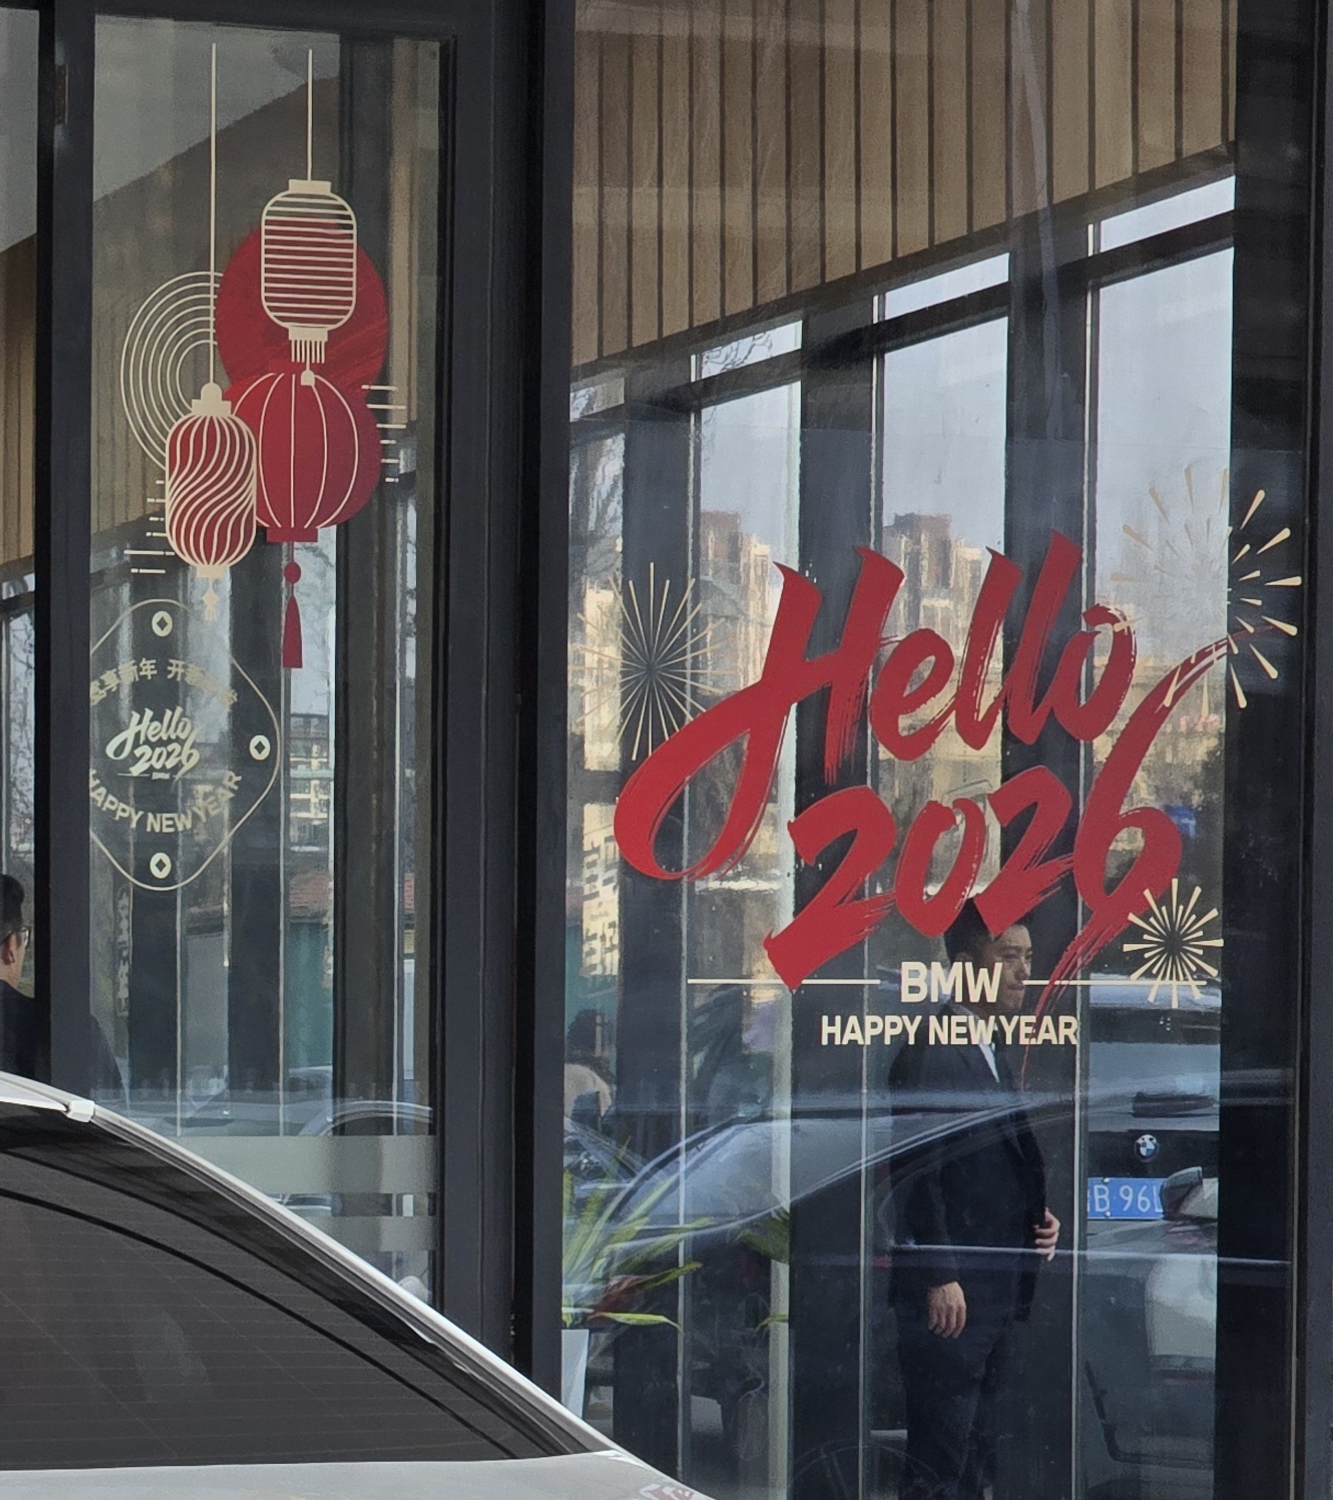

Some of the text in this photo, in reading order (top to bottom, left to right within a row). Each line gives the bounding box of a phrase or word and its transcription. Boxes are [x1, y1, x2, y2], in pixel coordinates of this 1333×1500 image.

[105, 705, 190, 760] Hello
[613, 531, 1138, 881] Hello
[129, 725, 203, 786] 2026
[146, 812, 192, 833] NEW
[192, 770, 242, 823] YEAR
[763, 622, 1268, 1020] 2026
[900, 961, 1004, 1003] BMW
[821, 1015, 1079, 1046] HAPPY NEW YEAR
